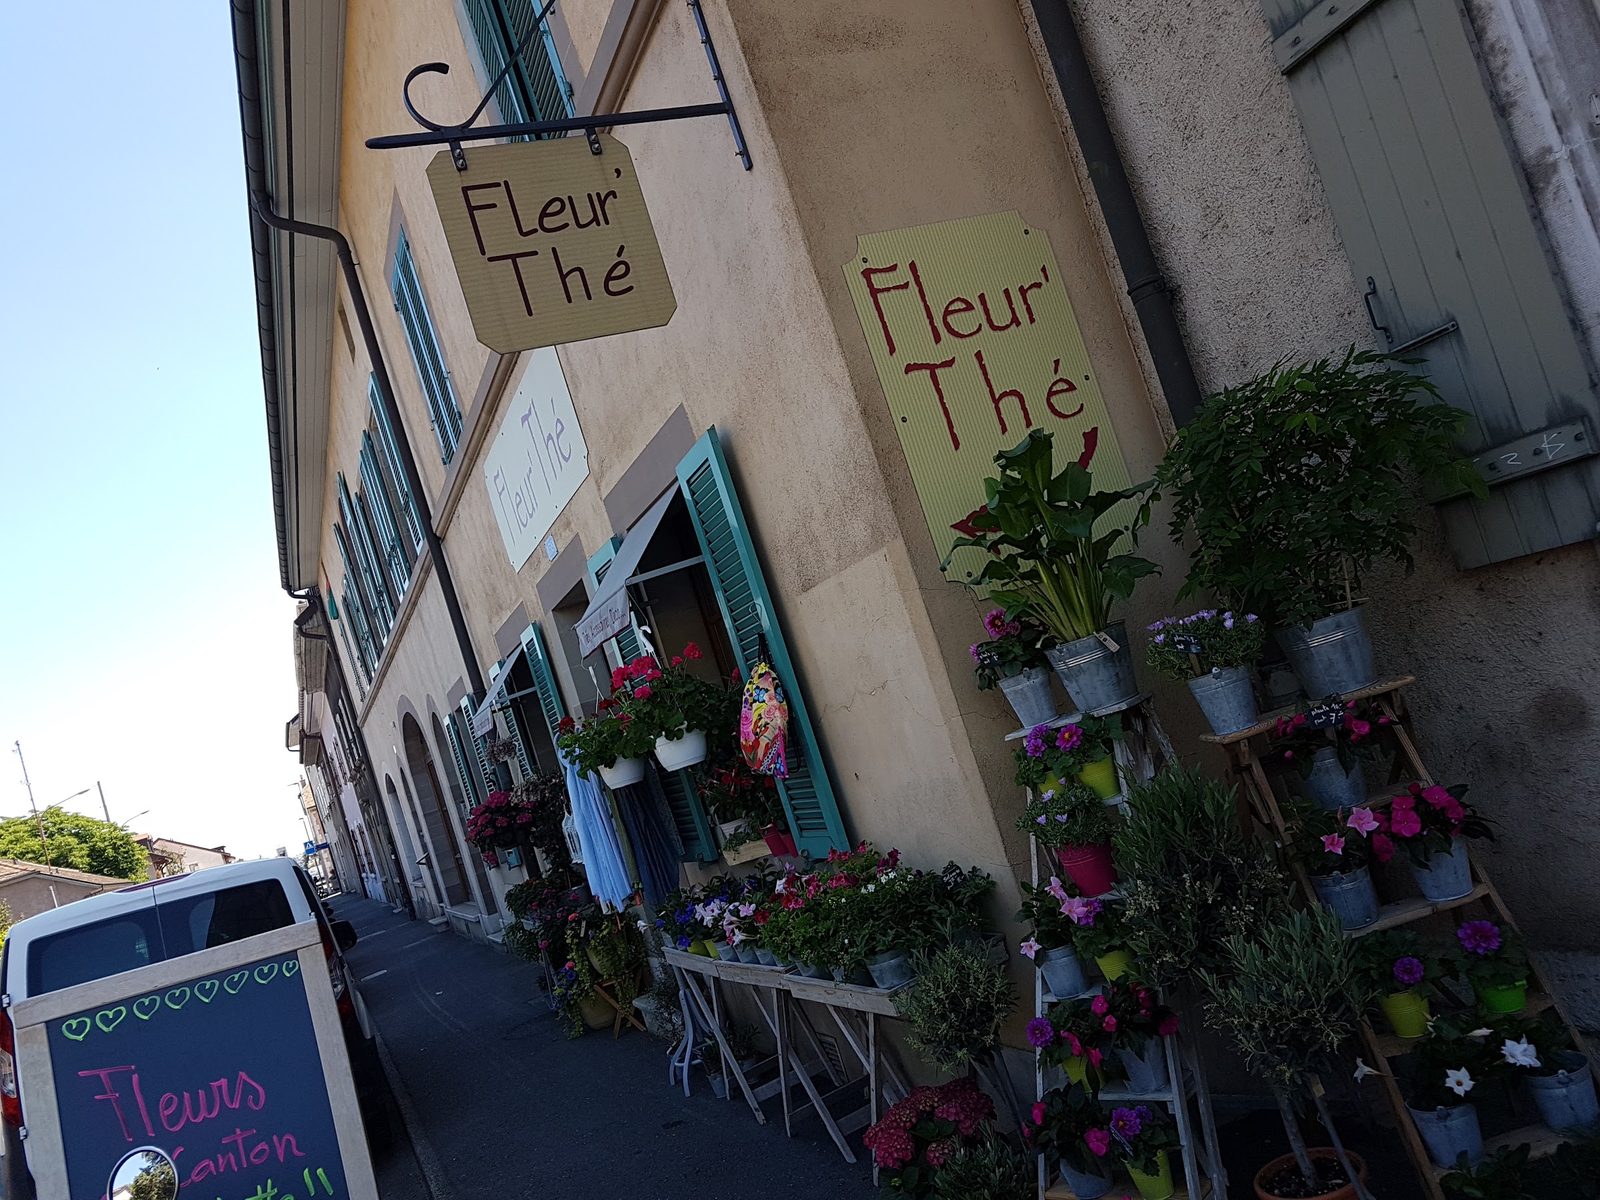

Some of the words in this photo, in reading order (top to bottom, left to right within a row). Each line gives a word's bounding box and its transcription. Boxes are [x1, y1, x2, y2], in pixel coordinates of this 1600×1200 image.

[487, 244, 634, 317] Thé
[904, 349, 1084, 451] Thé
[520, 397, 572, 496] Thé
[78, 1065, 266, 1142] Fleurs
